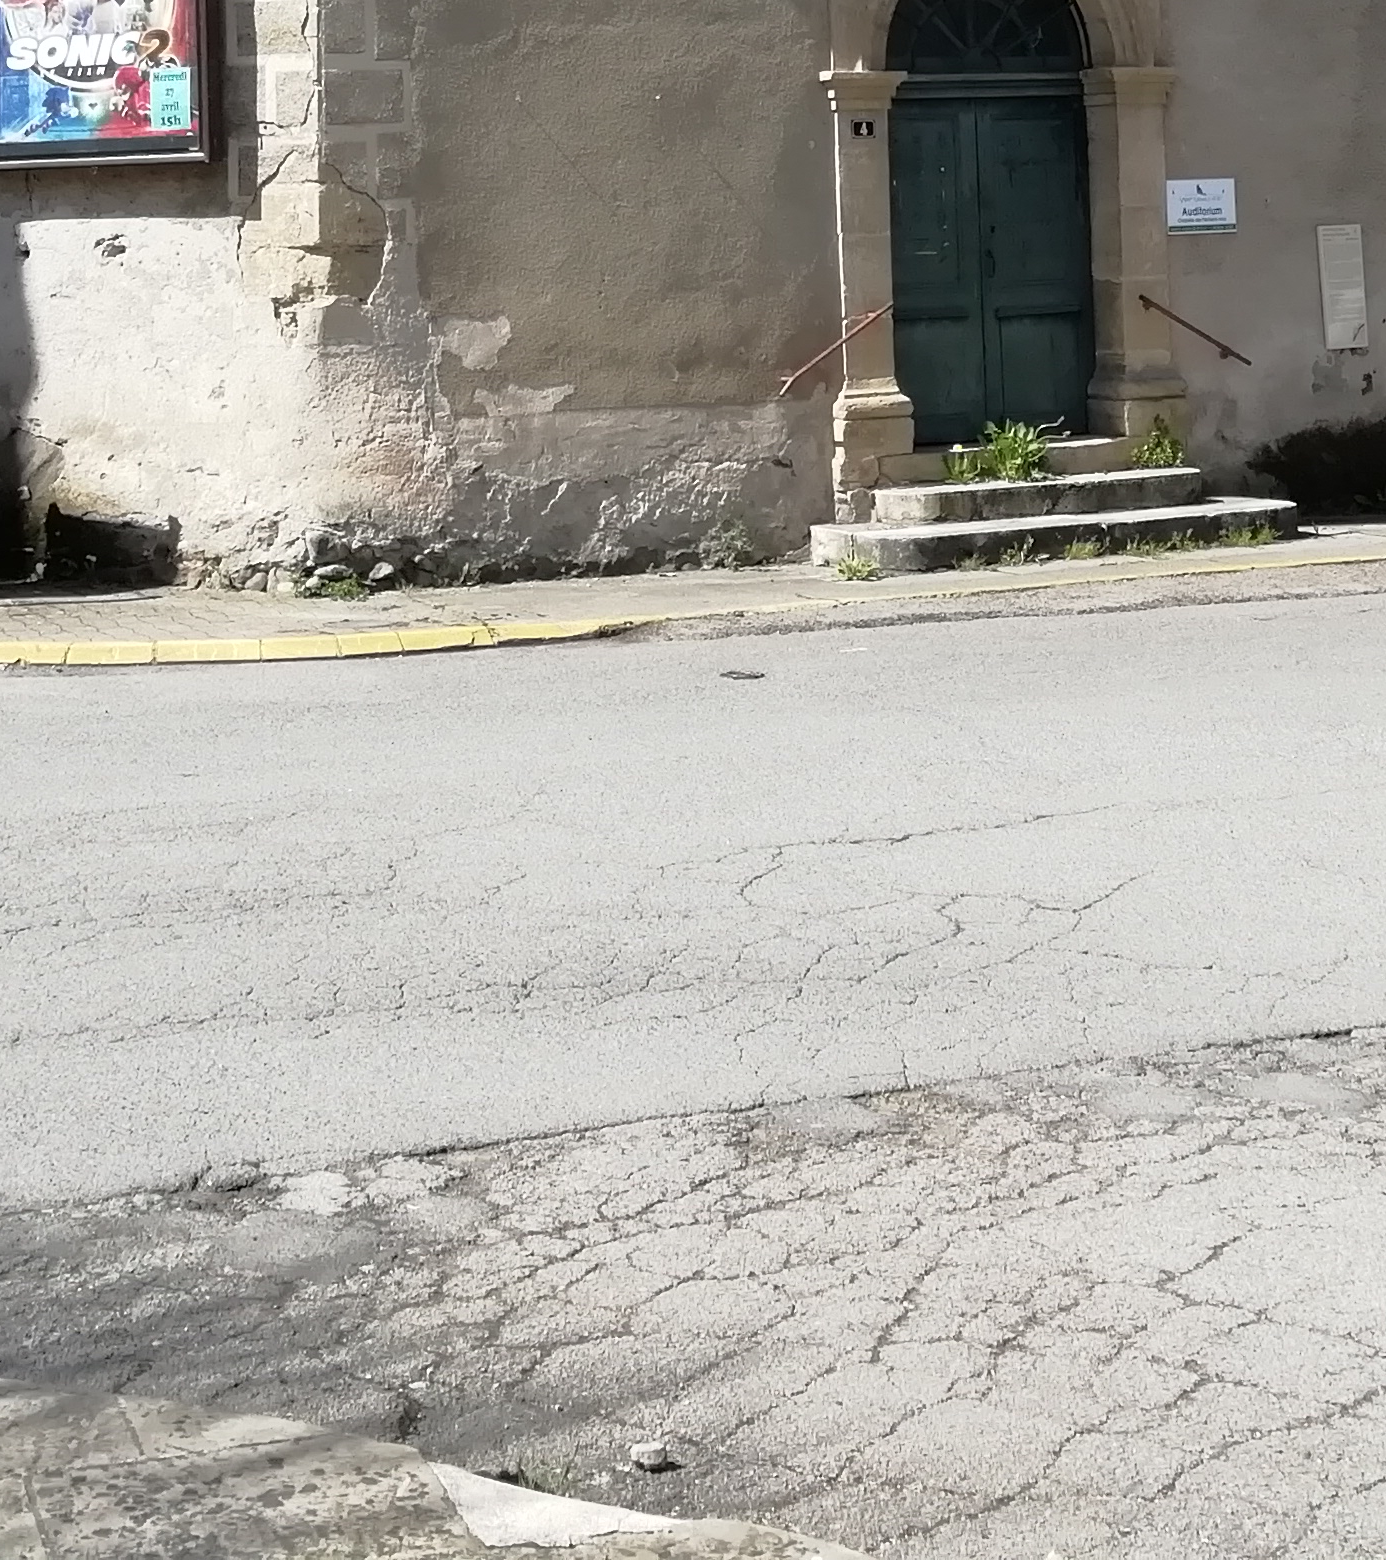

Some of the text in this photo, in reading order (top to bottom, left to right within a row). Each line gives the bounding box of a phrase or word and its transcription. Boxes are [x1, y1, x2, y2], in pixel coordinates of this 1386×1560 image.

[6, 29, 172, 71] SONIC 2
[67, 66, 106, 77] FILM
[153, 71, 187, 82] Mercredi
[162, 101, 179, 111] avril
[161, 115, 181, 126] 15h
[1182, 207, 1223, 216] Auditorium
